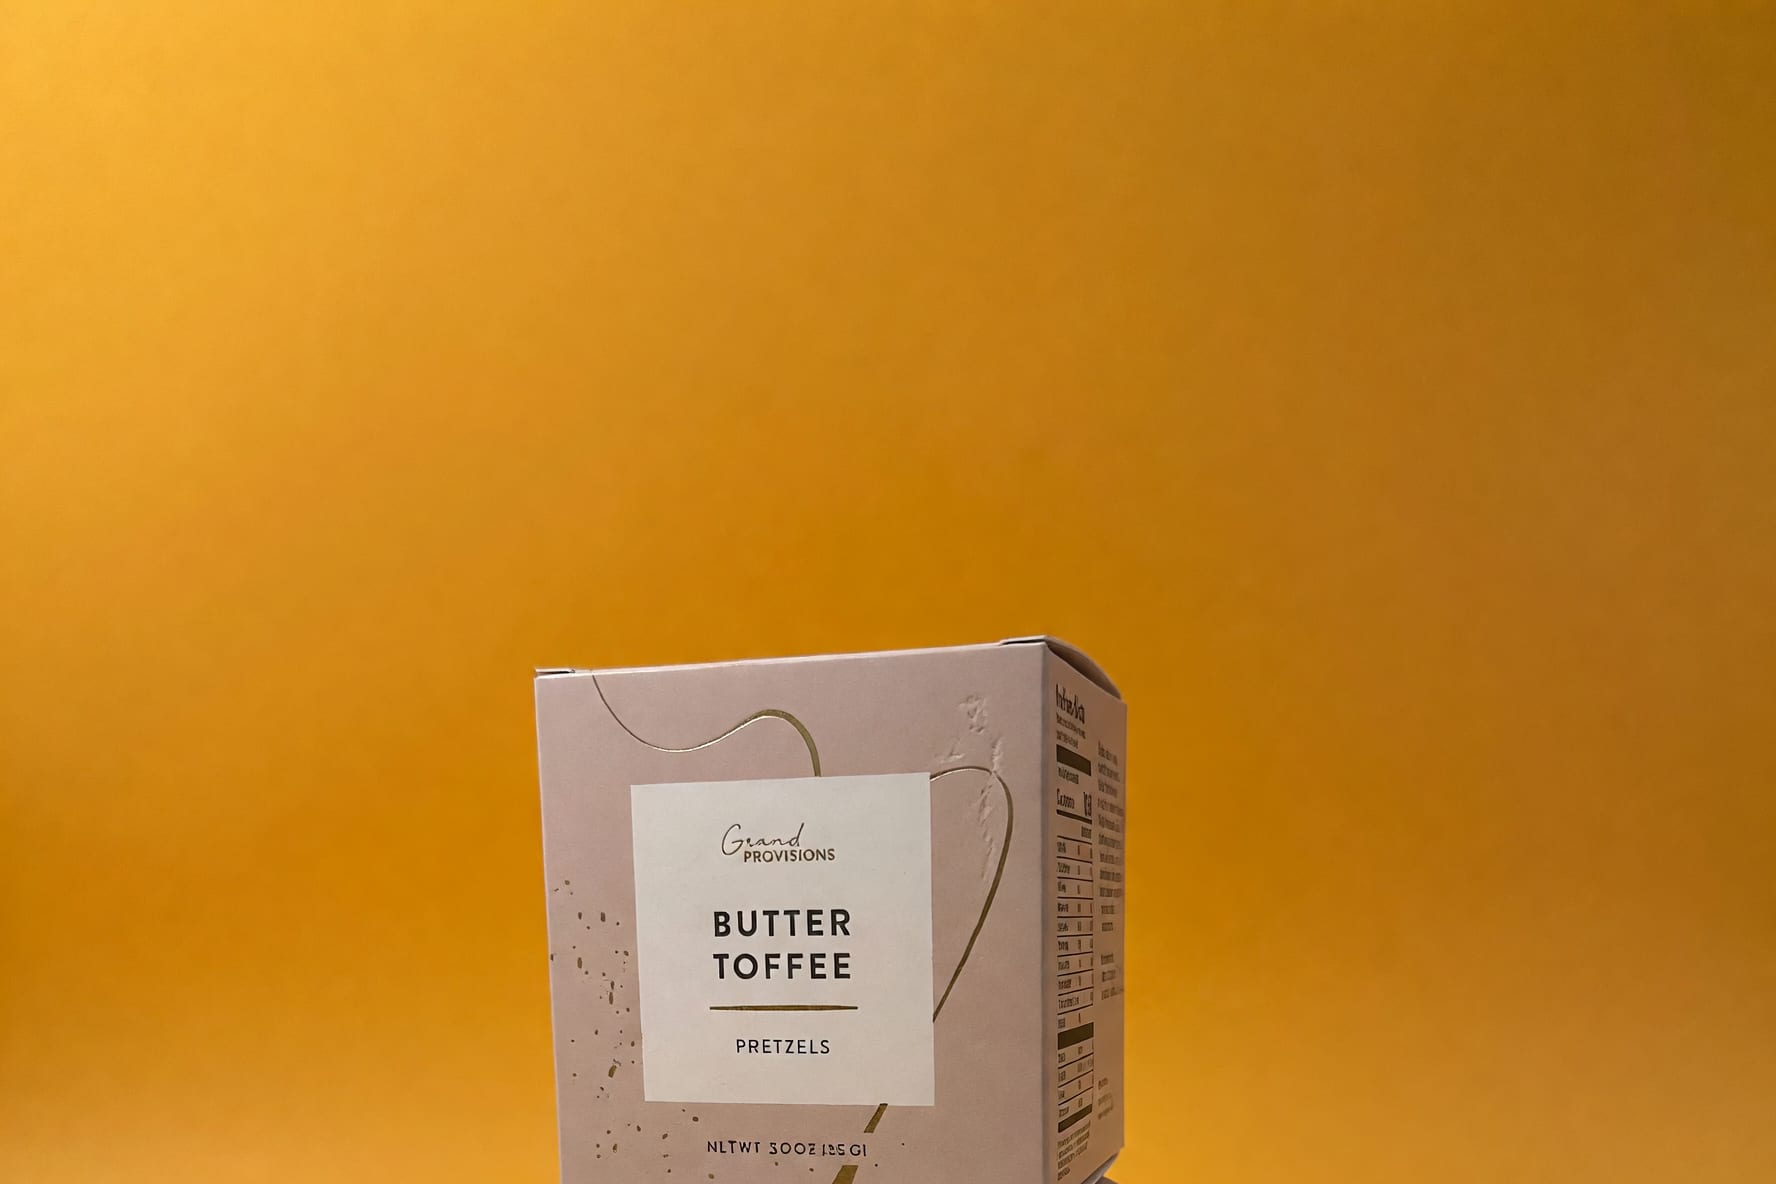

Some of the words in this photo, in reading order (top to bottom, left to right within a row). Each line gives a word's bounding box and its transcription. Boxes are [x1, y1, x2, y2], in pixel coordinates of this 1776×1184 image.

[721, 822, 805, 856] Grand
[743, 848, 836, 863] PROVISIONS
[713, 908, 851, 938] BUTTER
[712, 952, 851, 980] TOFFEE
[736, 1038, 830, 1055] PRETZELS
